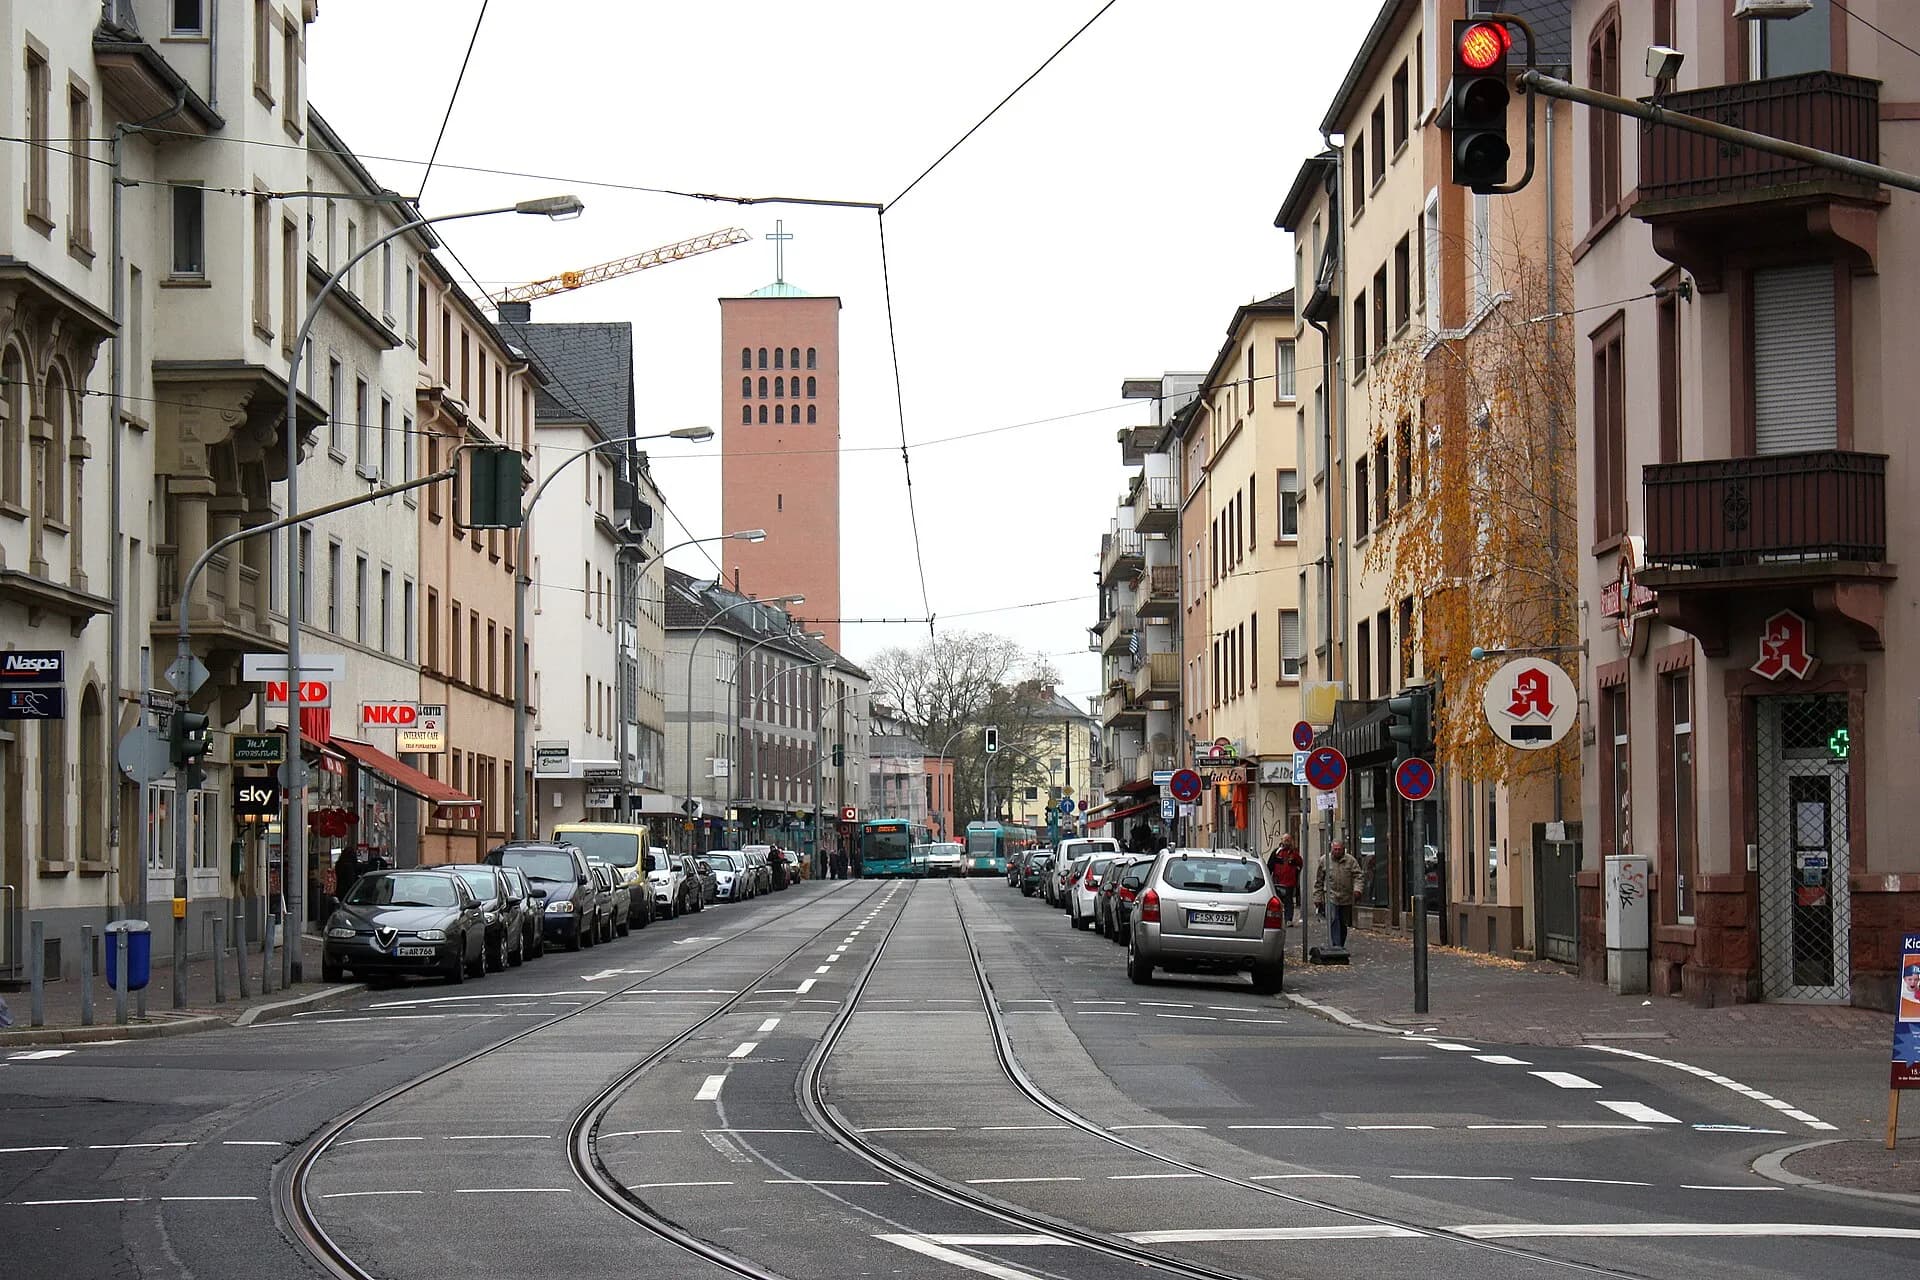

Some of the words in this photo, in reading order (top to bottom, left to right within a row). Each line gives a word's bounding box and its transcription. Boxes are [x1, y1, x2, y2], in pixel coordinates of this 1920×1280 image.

[6, 655, 59, 671] Naspa
[363, 705, 416, 724] NKD
[403, 731, 424, 740] INTERNET
[239, 784, 272, 806] sky
